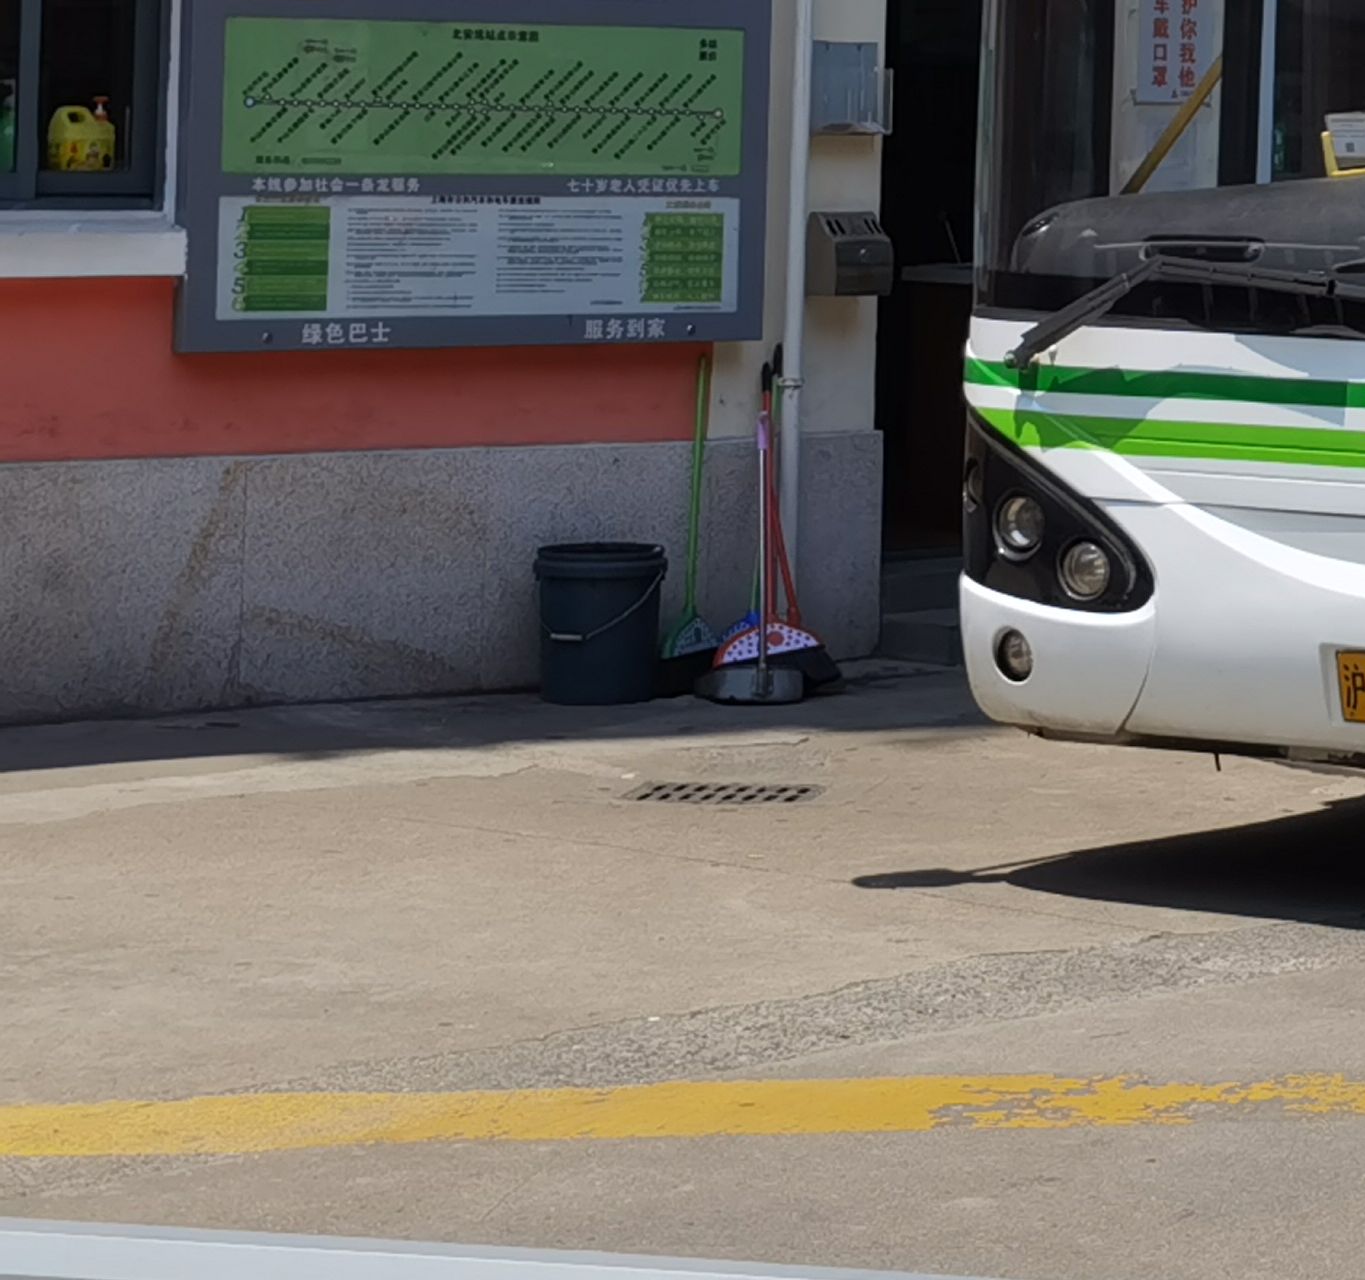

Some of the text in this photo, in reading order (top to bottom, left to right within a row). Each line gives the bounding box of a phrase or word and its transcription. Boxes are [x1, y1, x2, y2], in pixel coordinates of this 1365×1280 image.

[302, 322, 391, 344] 绿色巴士
[584, 317, 667, 339] 服务到家
